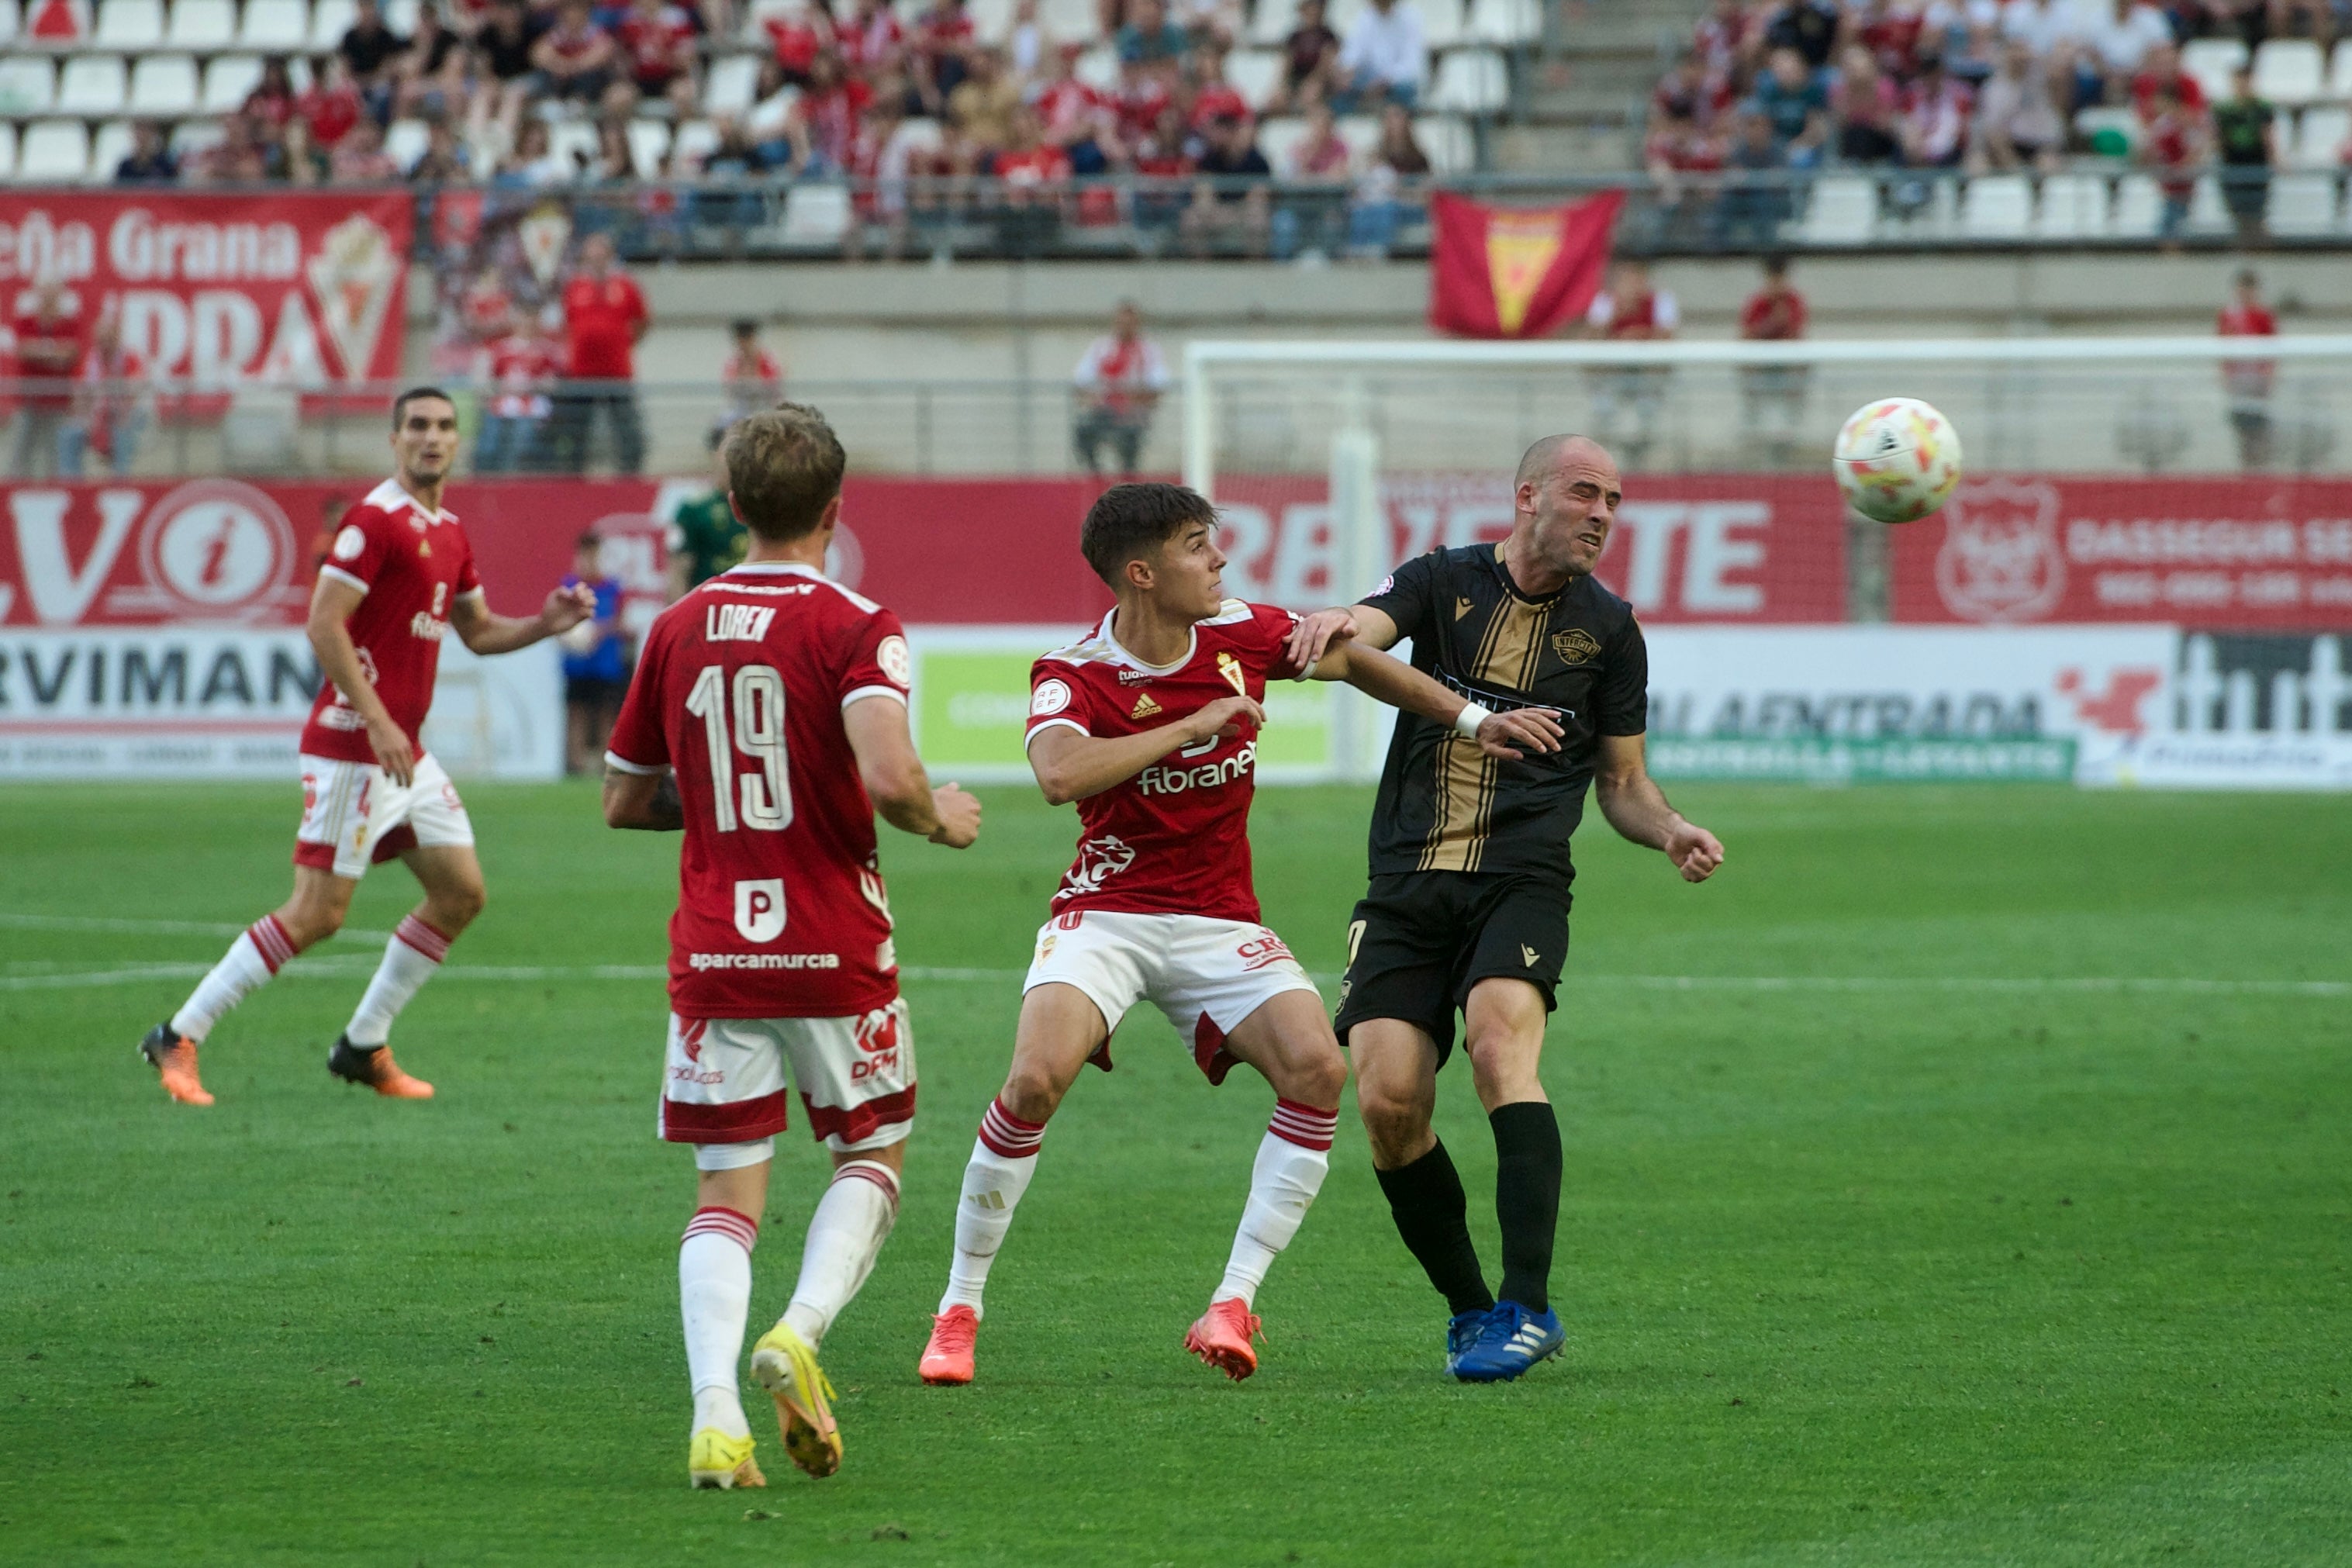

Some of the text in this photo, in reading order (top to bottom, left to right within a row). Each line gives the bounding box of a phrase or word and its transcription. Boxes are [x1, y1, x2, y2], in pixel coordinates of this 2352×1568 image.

[109, 207, 301, 281] Grana
[706, 604, 776, 642] LOREN
[1131, 704, 1162, 720] adidas
[686, 665, 794, 833] 19
[689, 952, 840, 972] aparcamurcia
[851, 1049, 897, 1079] DFM
